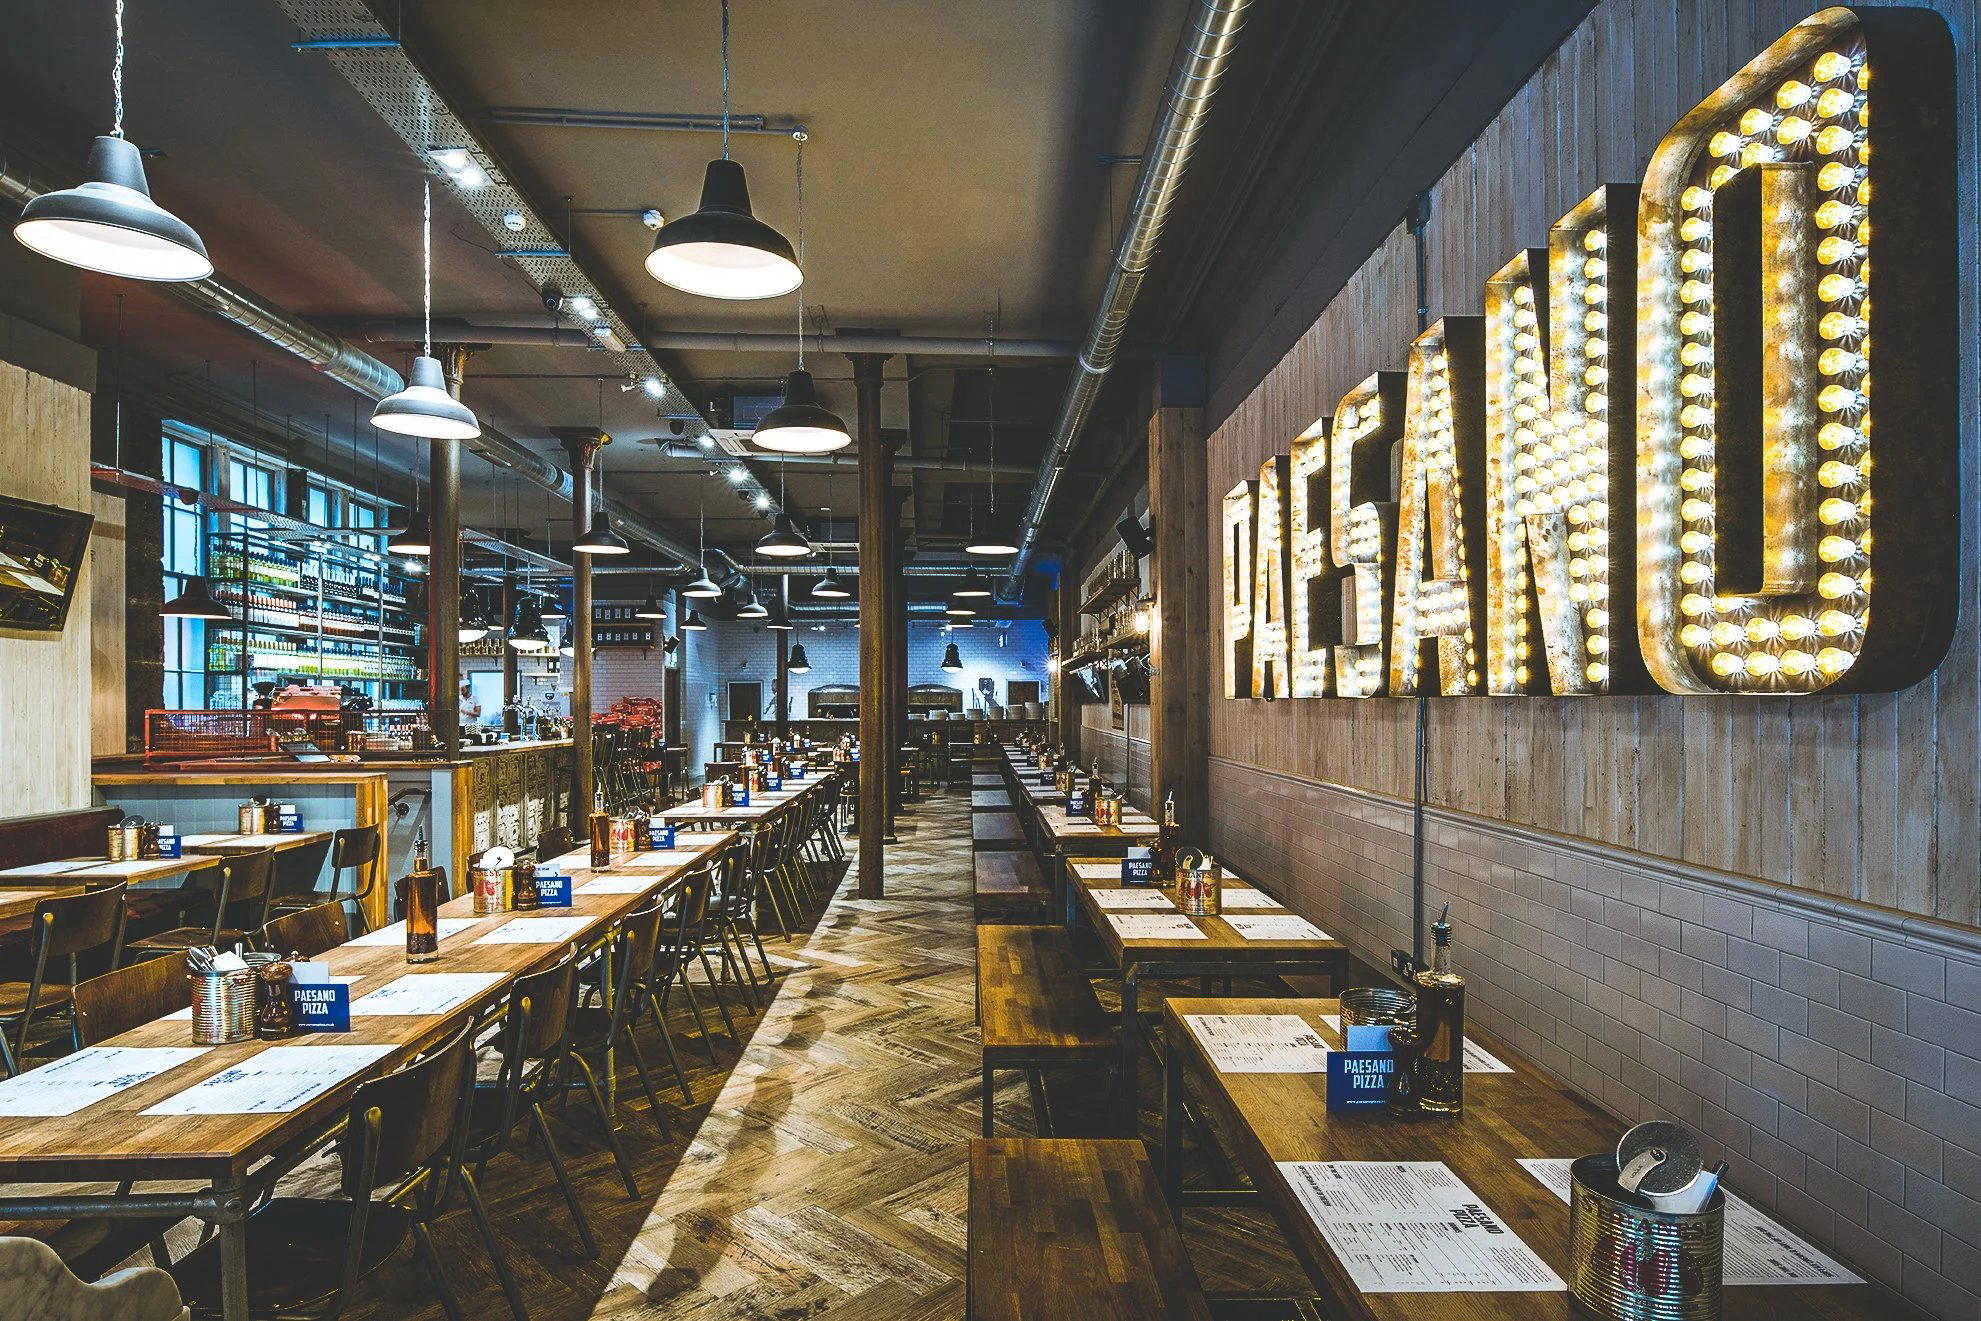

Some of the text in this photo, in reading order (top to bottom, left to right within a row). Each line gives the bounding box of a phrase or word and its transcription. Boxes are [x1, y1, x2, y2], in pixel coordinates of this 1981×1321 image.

[1223, 5, 1956, 699] PAESANO
[535, 880, 563, 889] PAESANO
[540, 888, 559, 897] PIZZA
[294, 989, 336, 1002] PAESANO
[302, 1002, 329, 1015] PIZZA
[1344, 1059, 1394, 1074] PAESANO
[1353, 1074, 1384, 1089] PIZZA
[1448, 1209, 1480, 1229] PIZZA
[1461, 1204, 1505, 1234] PAESANO
